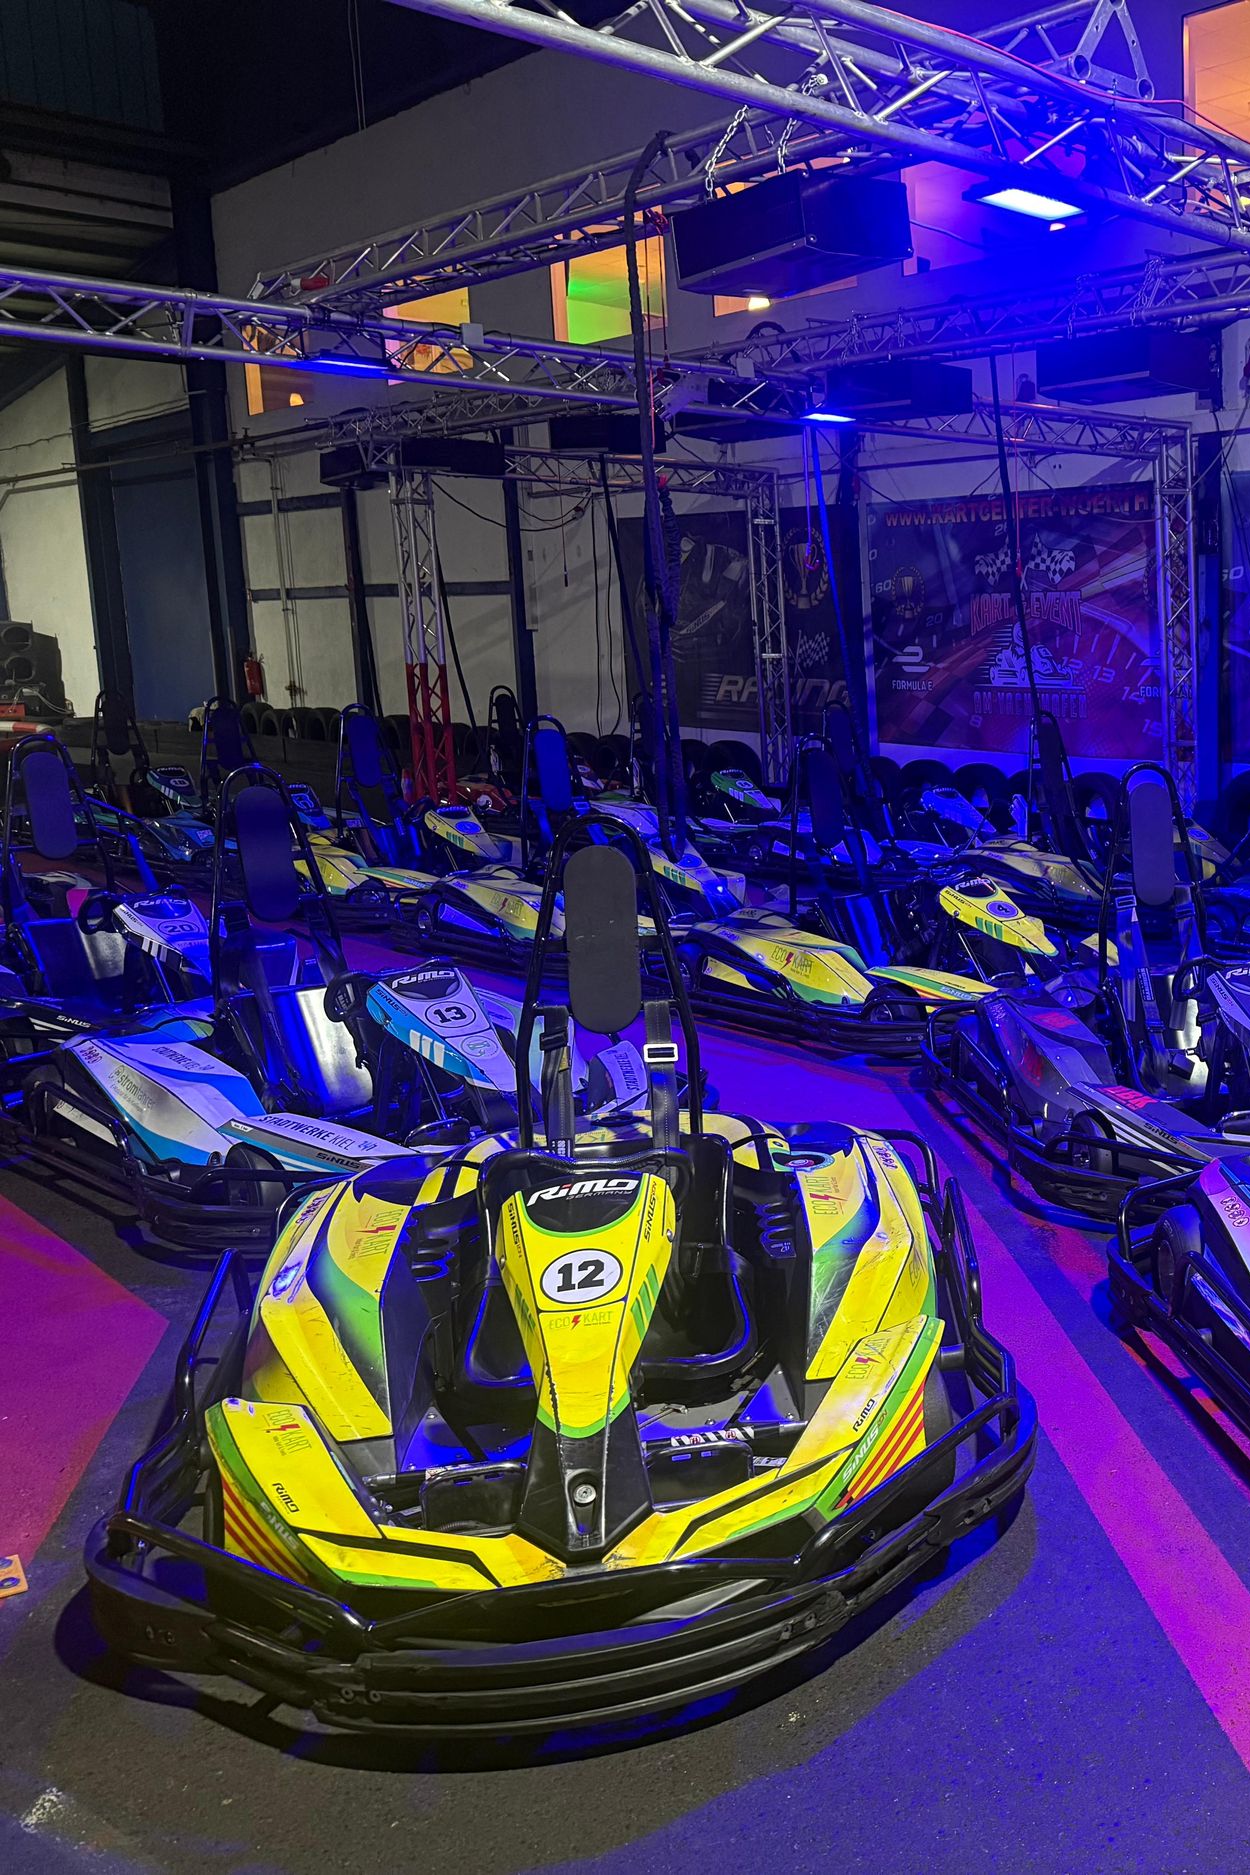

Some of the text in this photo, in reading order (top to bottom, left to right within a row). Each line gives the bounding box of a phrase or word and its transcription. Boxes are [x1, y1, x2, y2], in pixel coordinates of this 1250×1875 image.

[970, 592, 1012, 637] KART
[1029, 590, 1084, 636] EVENT
[164, 923, 195, 934] 20
[433, 1006, 467, 1024] 13
[258, 1115, 335, 1141] STADTWERKE
[329, 1134, 356, 1151] KIEL
[556, 1259, 606, 1293] 12
[549, 1317, 572, 1330] ECO
[583, 1311, 613, 1324] KART
